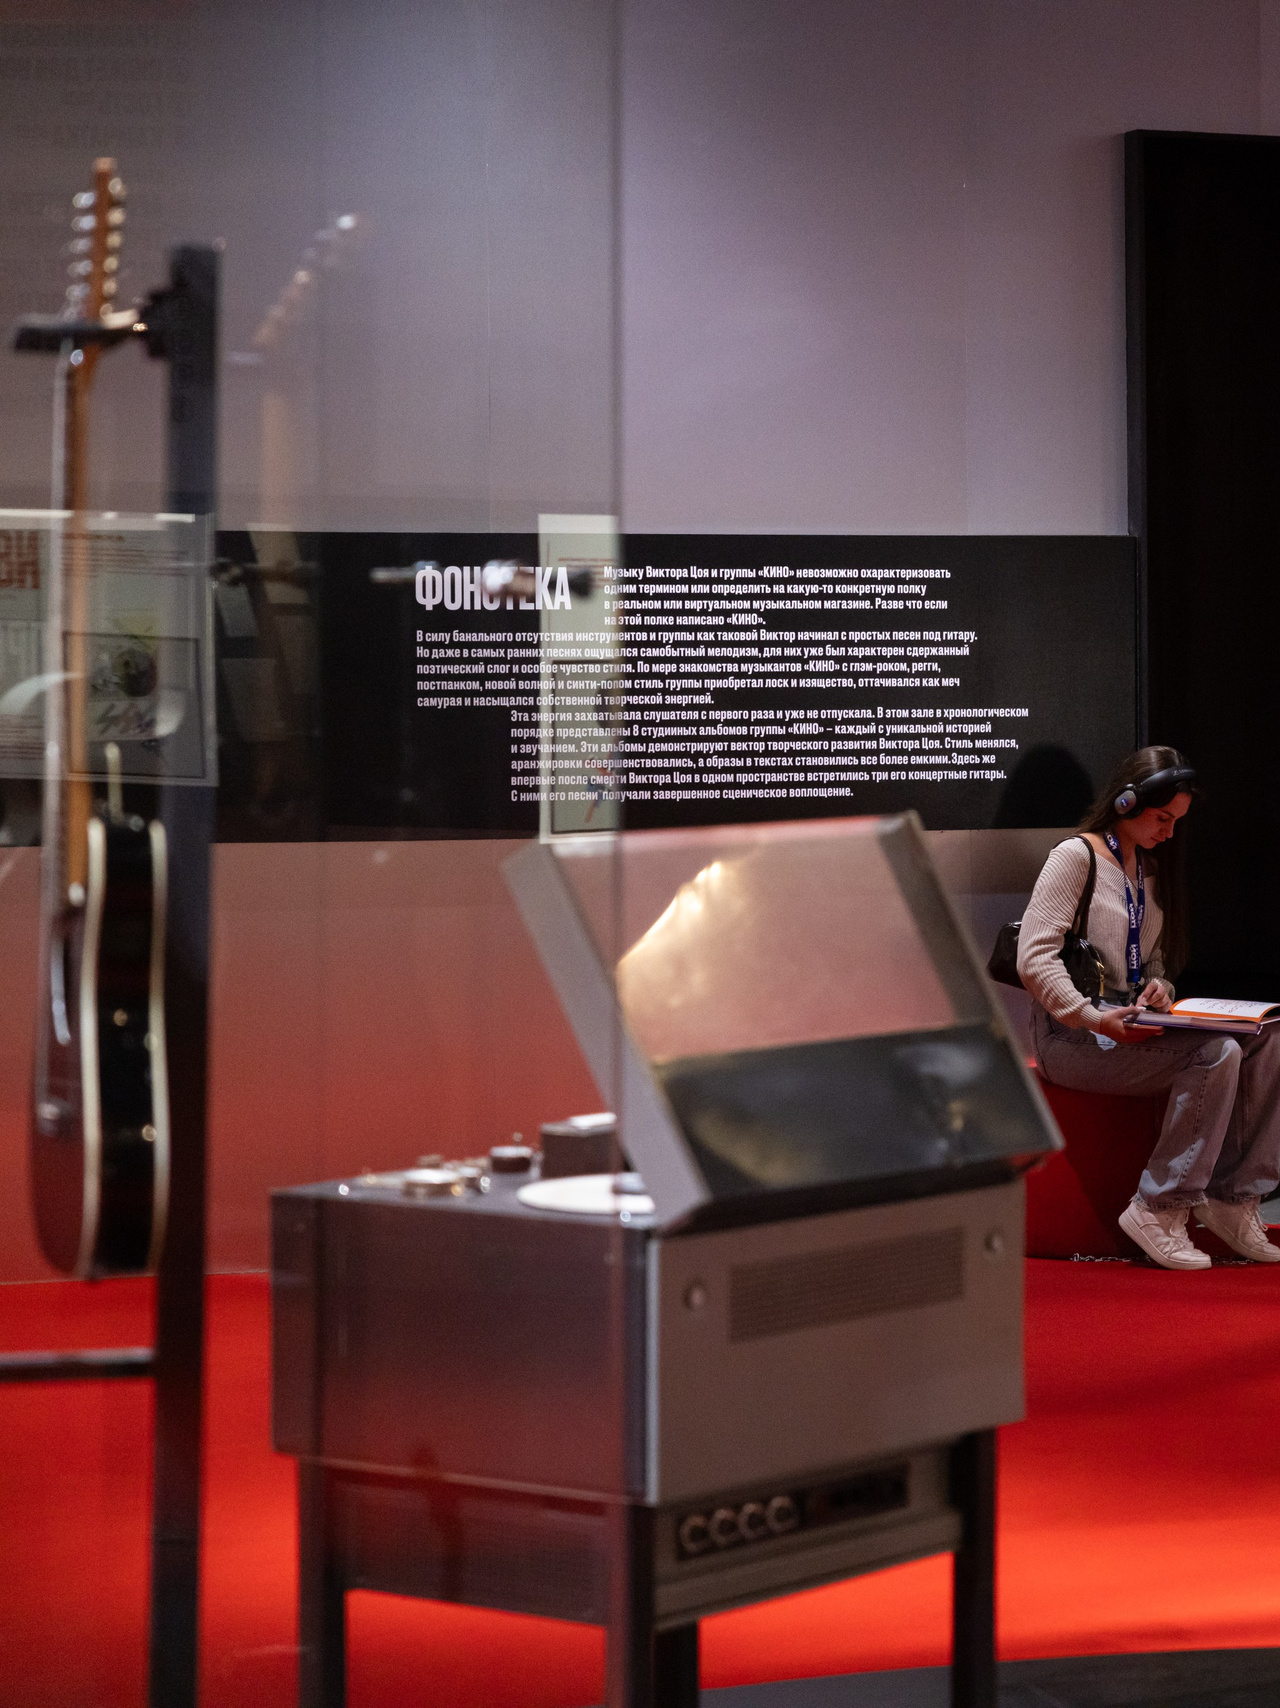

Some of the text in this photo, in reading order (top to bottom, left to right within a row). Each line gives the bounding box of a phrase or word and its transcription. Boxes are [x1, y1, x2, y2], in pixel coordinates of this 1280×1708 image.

[604, 566, 950, 581] Музыку Виктора Цоя и группы «КИНО» невозможно охарактеризовать
[604, 597, 948, 612] в реальном или виртуальном музыкальном магазине. Разве что если
[416, 629, 978, 644] В силу банального отсутствия инструментов и группы как таковой Виктор начинал с простых песен под гитару.
[416, 677, 960, 692] постпанком, новой волной и синти-попом стиль группы приобретал лоск и изящество, оттачивался как меч
[510, 770, 1008, 788] впервые после смерти Виктора Цоя в одном пространстве встретились три его концертные гитары.
[1129, 944, 1138, 969] ЦОЙ
